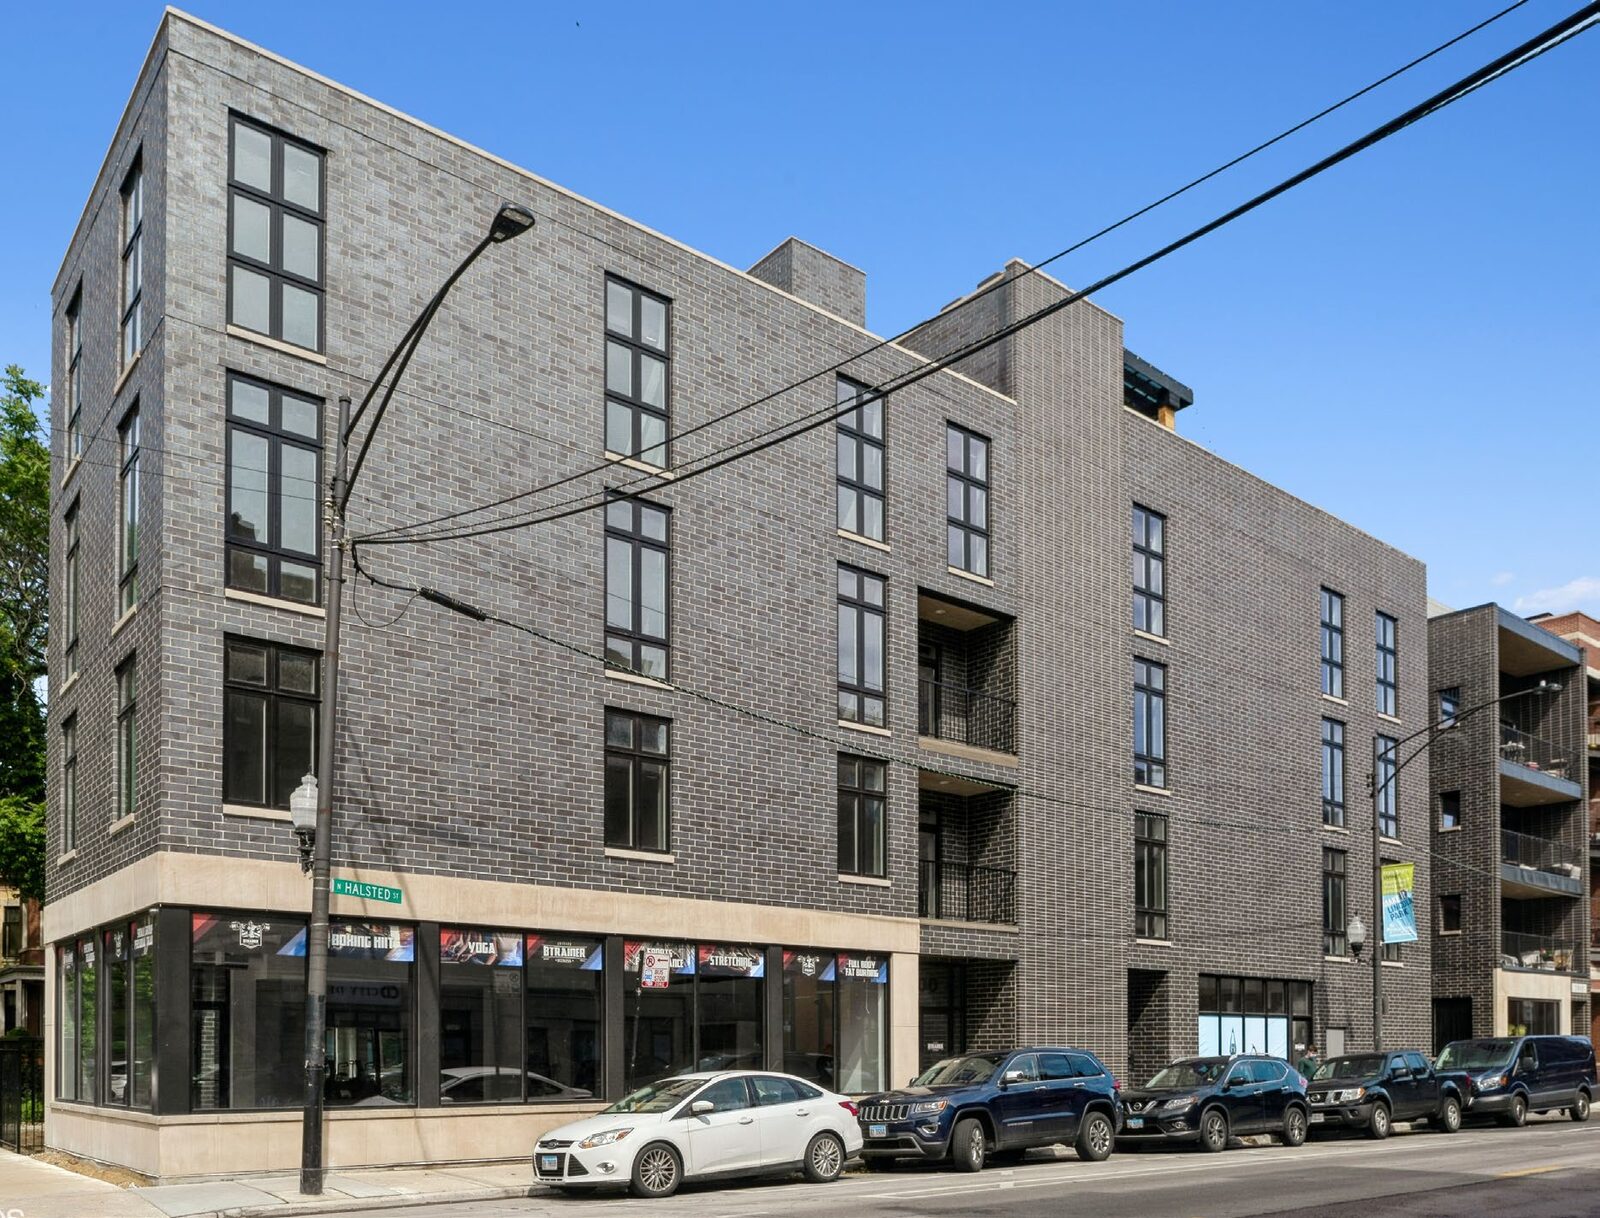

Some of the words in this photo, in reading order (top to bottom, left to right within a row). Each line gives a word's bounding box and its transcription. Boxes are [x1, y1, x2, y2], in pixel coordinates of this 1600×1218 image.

[336, 882, 342, 890] N
[344, 882, 391, 901] HALSTED
[392, 892, 399, 900] ST
[1389, 908, 1409, 921] PARK
[331, 933, 371, 948] BOXING
[373, 935, 394, 949] HIIT
[468, 941, 496, 954] YOGA
[543, 945, 586, 957] BTRAINER
[709, 955, 753, 967] STRETCHING
[848, 959, 860, 968] FULL
[860, 960, 876, 969] BODY
[845, 967, 855, 976] FAT
